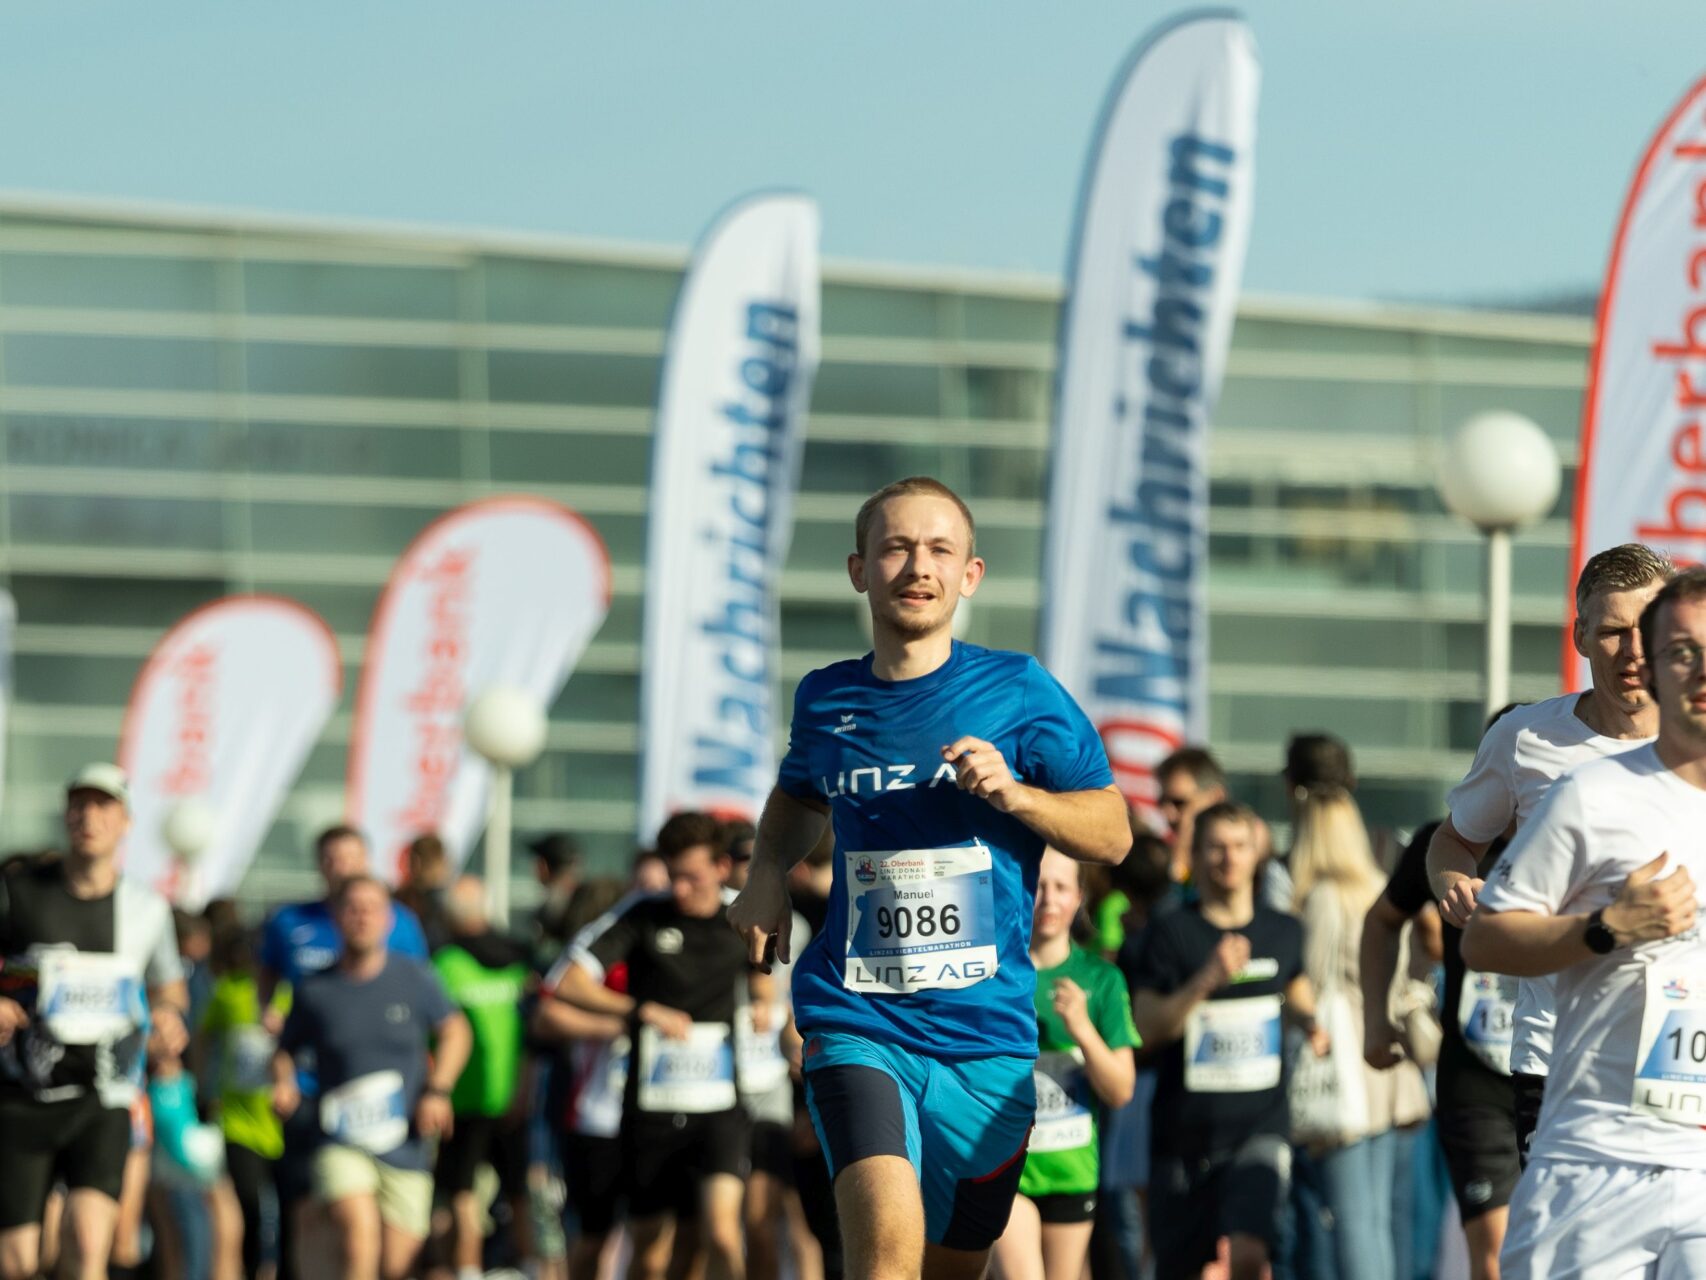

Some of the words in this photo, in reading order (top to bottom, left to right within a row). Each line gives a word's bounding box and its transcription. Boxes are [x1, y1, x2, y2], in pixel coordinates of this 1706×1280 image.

[822, 764, 916, 799] LINZ
[928, 762, 958, 789] A
[891, 859, 925, 868] Oberbank
[879, 873, 927, 881] MARATHON
[893, 888, 935, 901] Manuel
[877, 903, 961, 939] 9086
[855, 965, 928, 984] LINZ
[936, 961, 986, 982] AG
